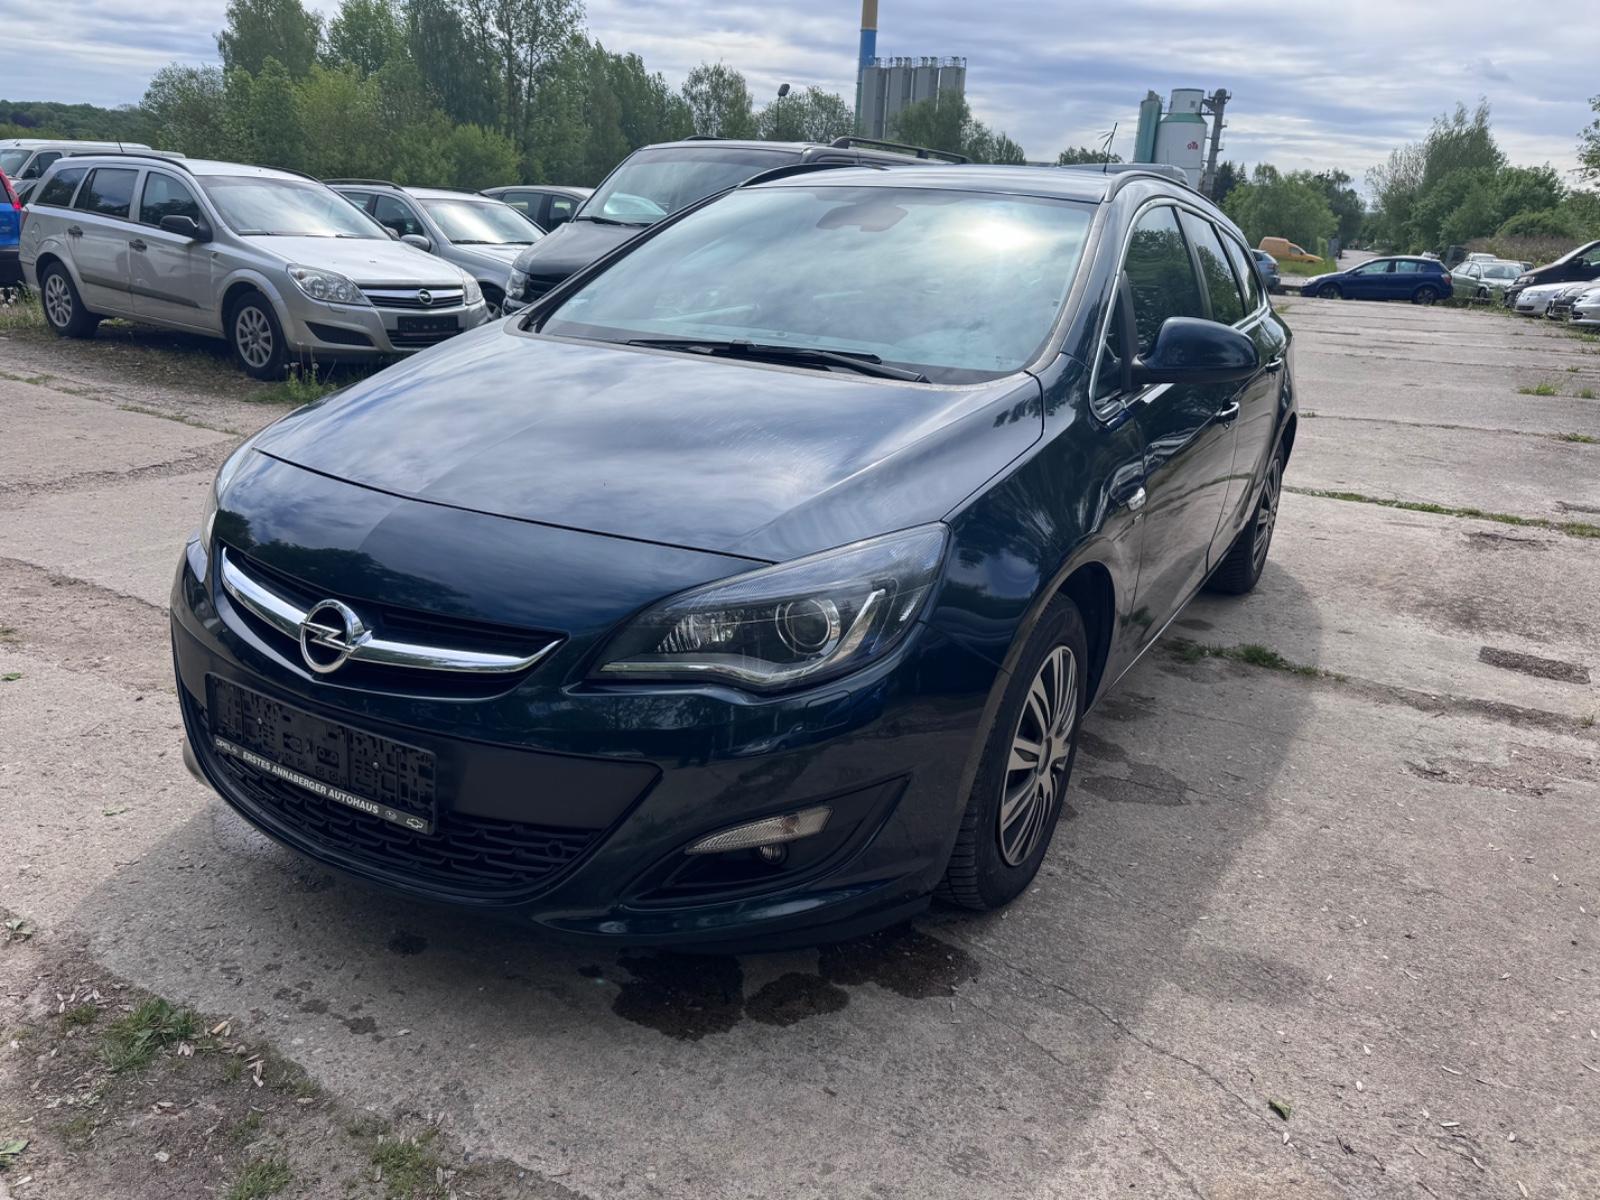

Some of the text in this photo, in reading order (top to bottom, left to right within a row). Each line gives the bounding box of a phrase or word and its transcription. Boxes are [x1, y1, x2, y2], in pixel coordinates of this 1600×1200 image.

[242, 751, 271, 770] ERSTES
[271, 765, 327, 794] ANNABERGER
[328, 789, 379, 814] AUTOHAUS
